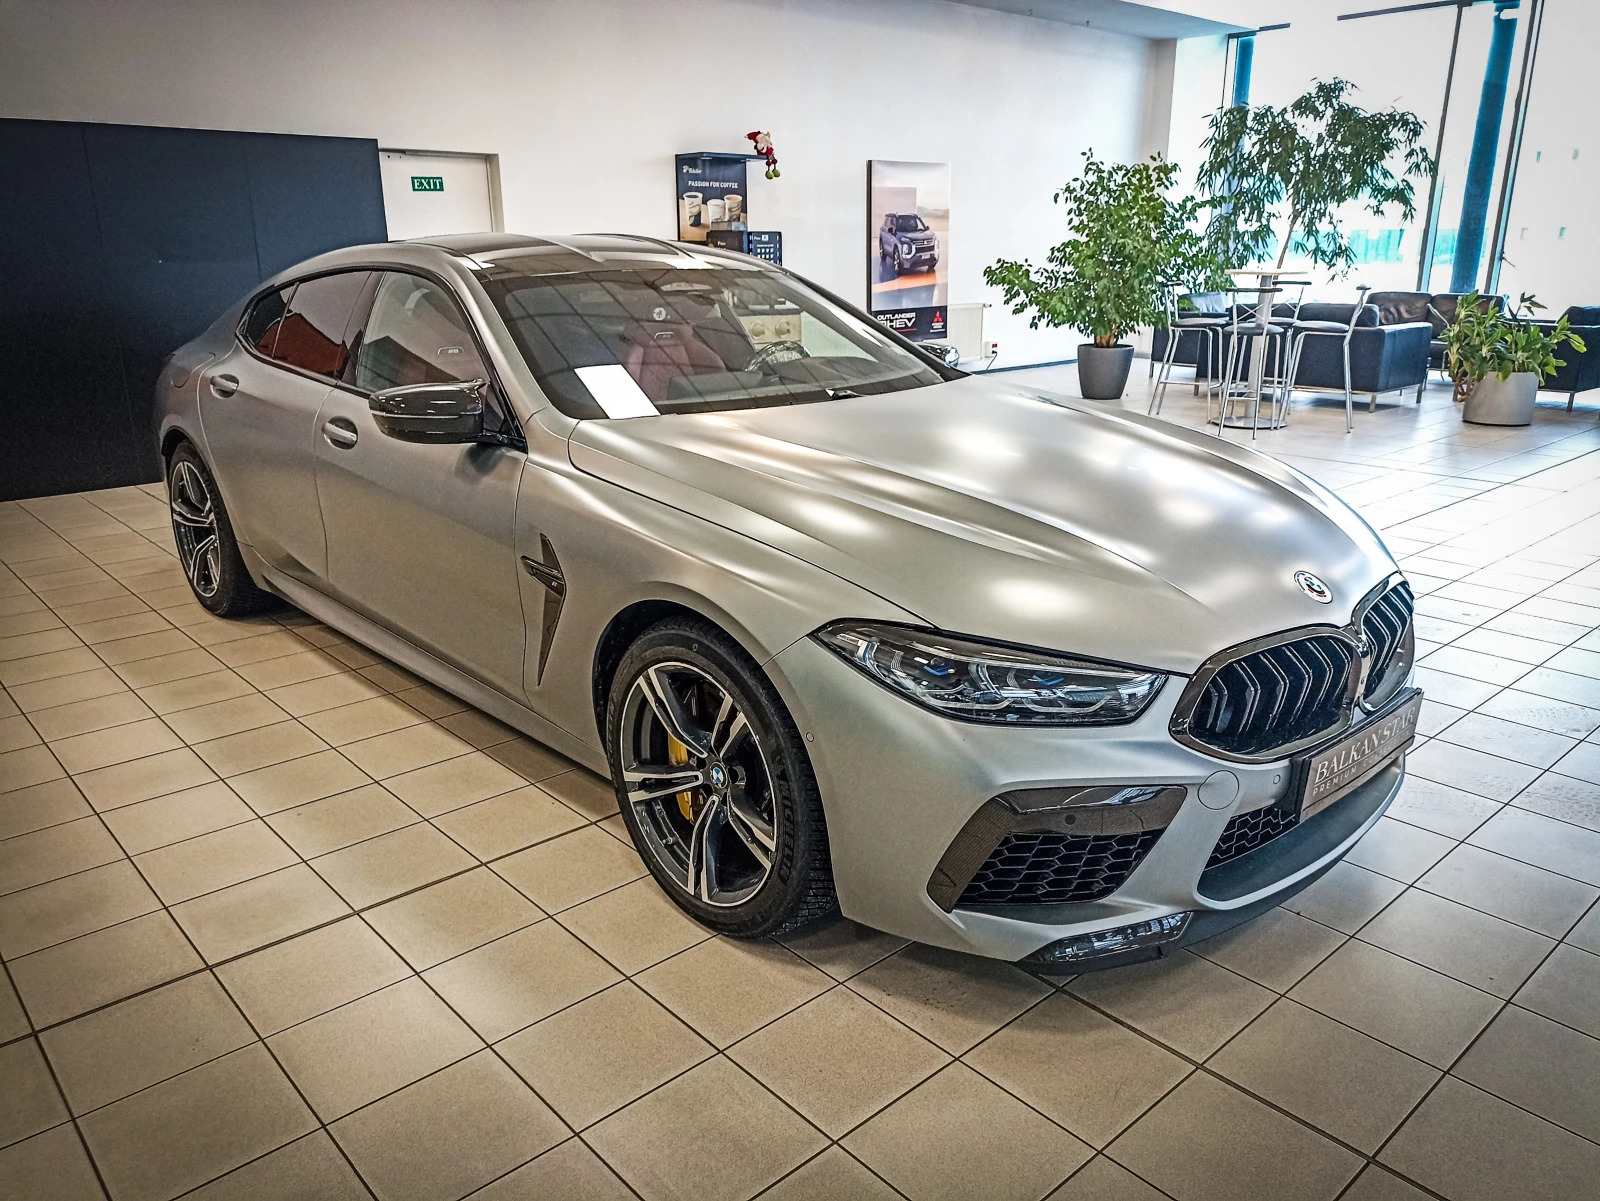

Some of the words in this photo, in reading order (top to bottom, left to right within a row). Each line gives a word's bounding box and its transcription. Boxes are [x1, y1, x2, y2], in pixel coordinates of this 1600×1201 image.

[413, 178, 442, 190] EXIT
[688, 180, 710, 188] PASSION
[877, 312, 916, 321] OUTLANDER
[1312, 765, 1358, 797] PREMIUM
